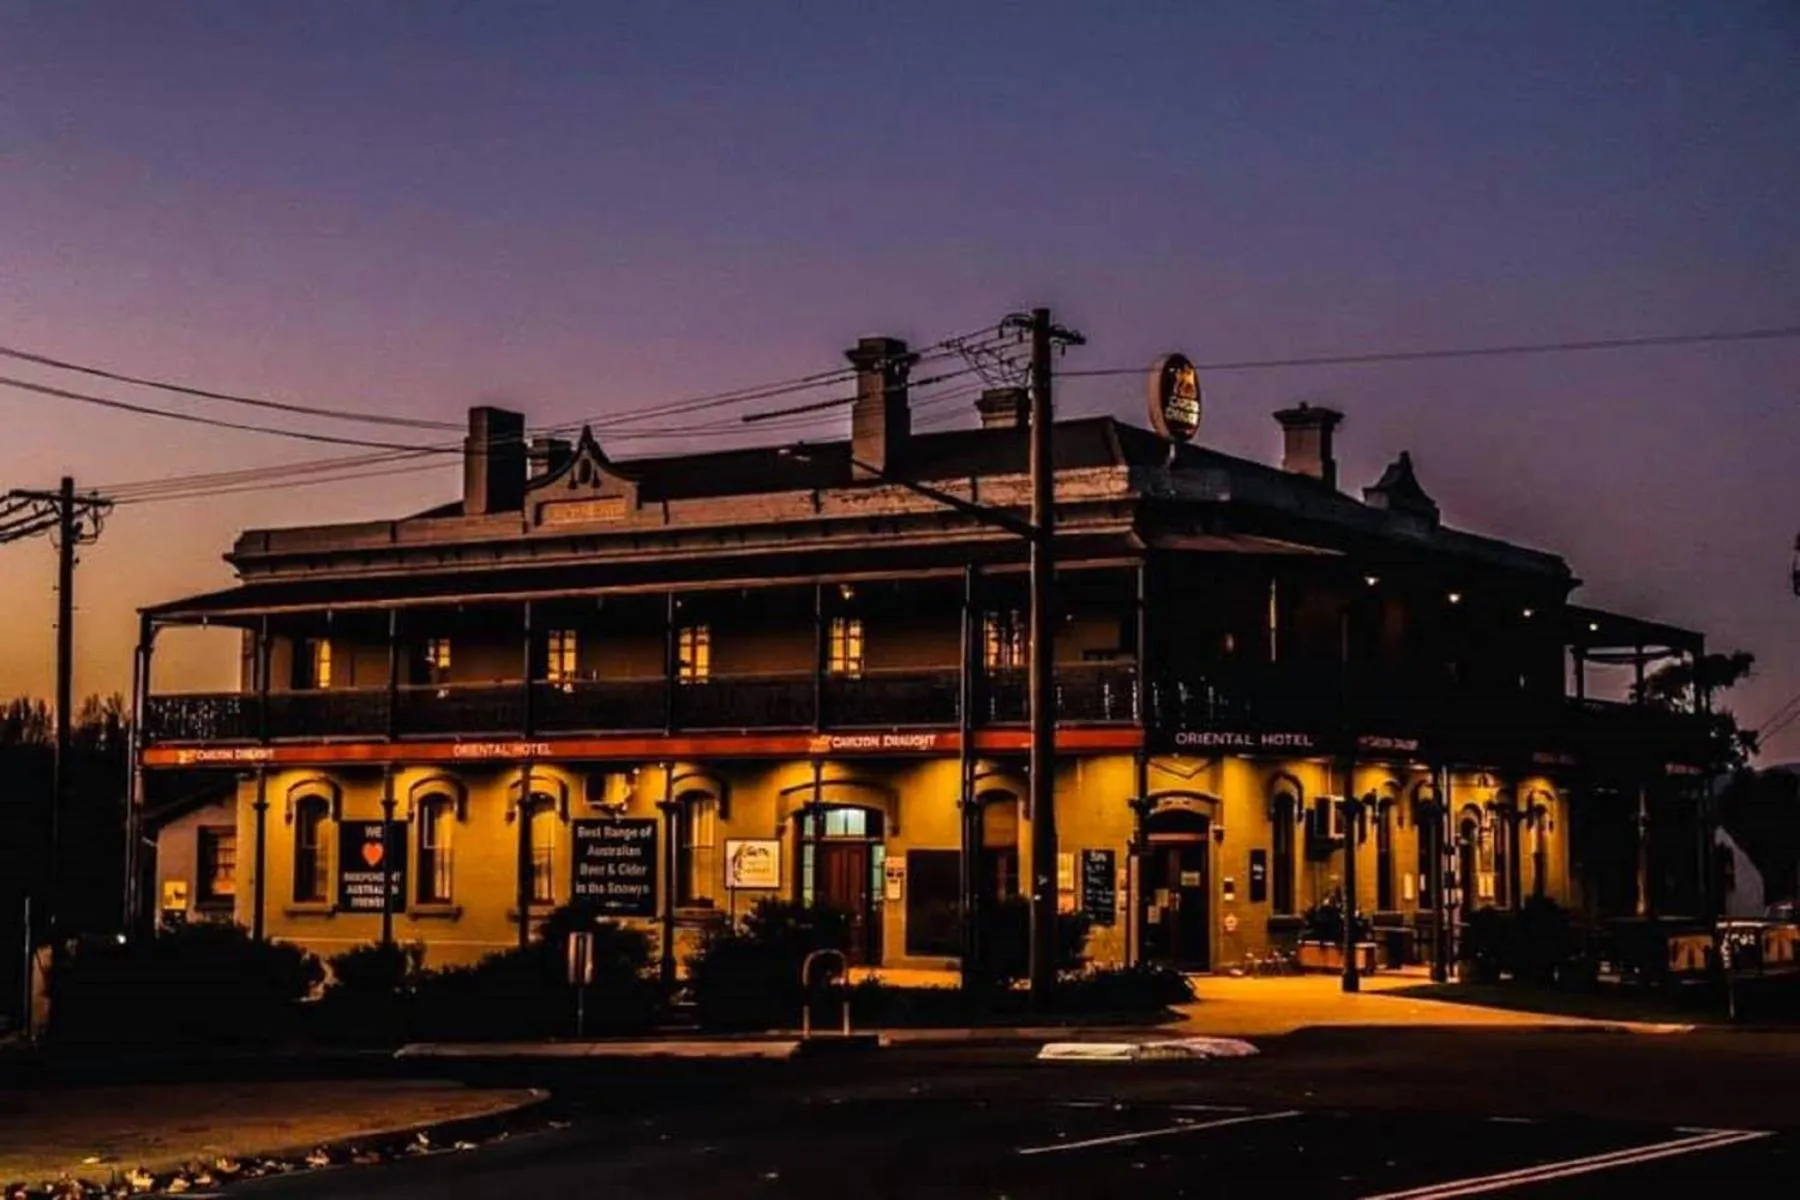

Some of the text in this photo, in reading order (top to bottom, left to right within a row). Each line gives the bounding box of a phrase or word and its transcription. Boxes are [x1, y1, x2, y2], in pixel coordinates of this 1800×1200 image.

[830, 734, 936, 749] CARLTON DRAUGHT
[1174, 731, 1314, 747] ORIENTAL HOTEL
[453, 743, 552, 757] ORIENTAL HOTEL
[364, 825, 384, 838] WE
[577, 825, 653, 841] Best Range of
[586, 844, 642, 857] Australian
[607, 862, 617, 875] &
[618, 862, 647, 876] Cider
[588, 881, 604, 894] the
